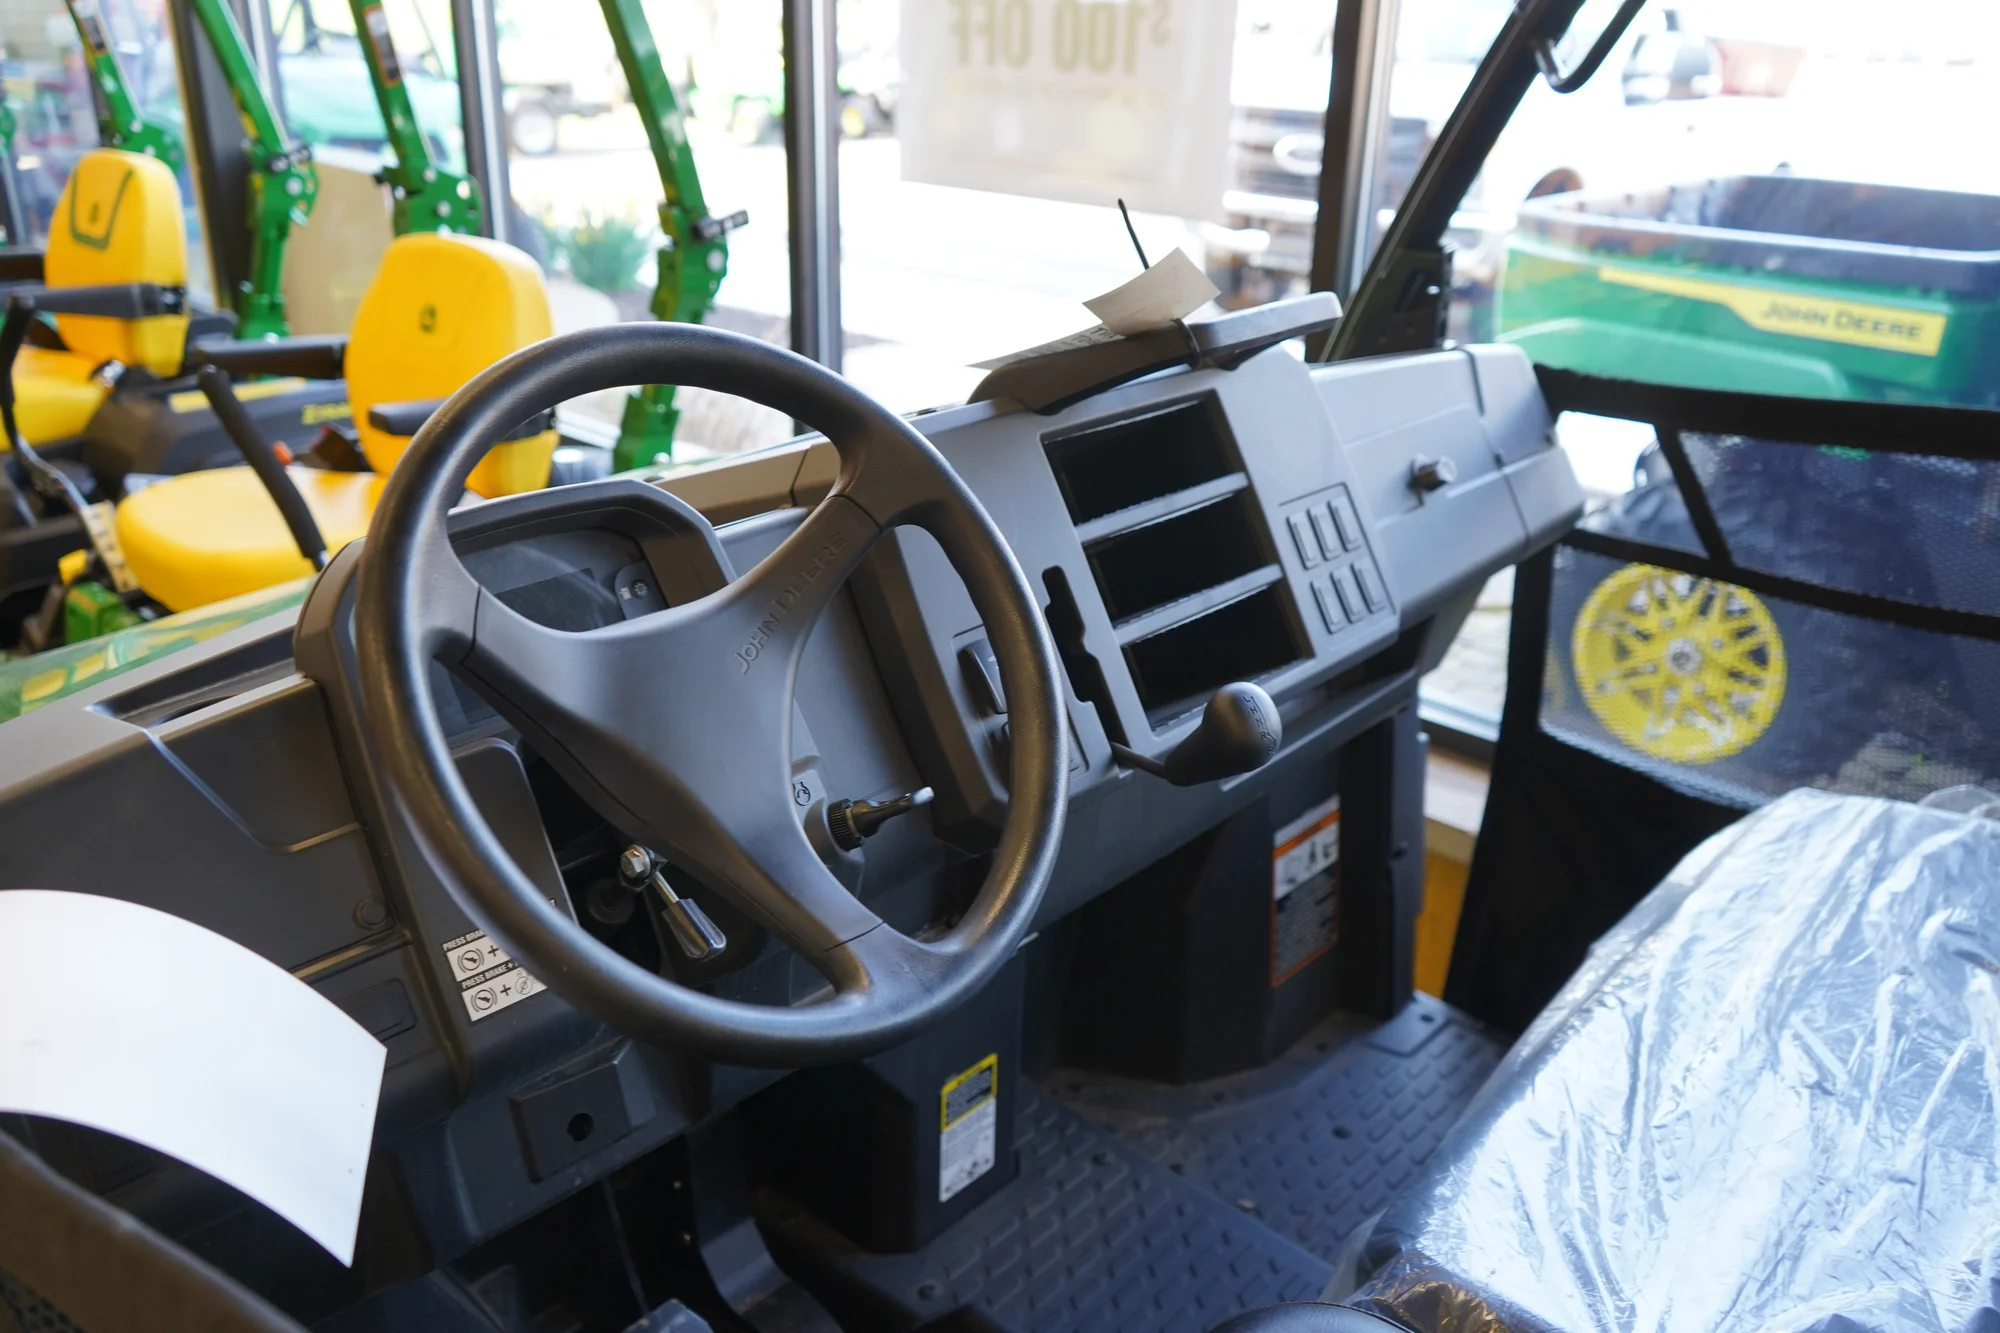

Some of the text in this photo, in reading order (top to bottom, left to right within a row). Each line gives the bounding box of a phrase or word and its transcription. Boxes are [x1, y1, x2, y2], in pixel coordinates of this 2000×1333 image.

[1762, 300, 1923, 341] JOHN DEERE
[734, 531, 849, 676] JOHN DEERE
[442, 937, 466, 950] PRESS
[461, 975, 485, 989] PRESS
[484, 965, 508, 979] BRAKE
